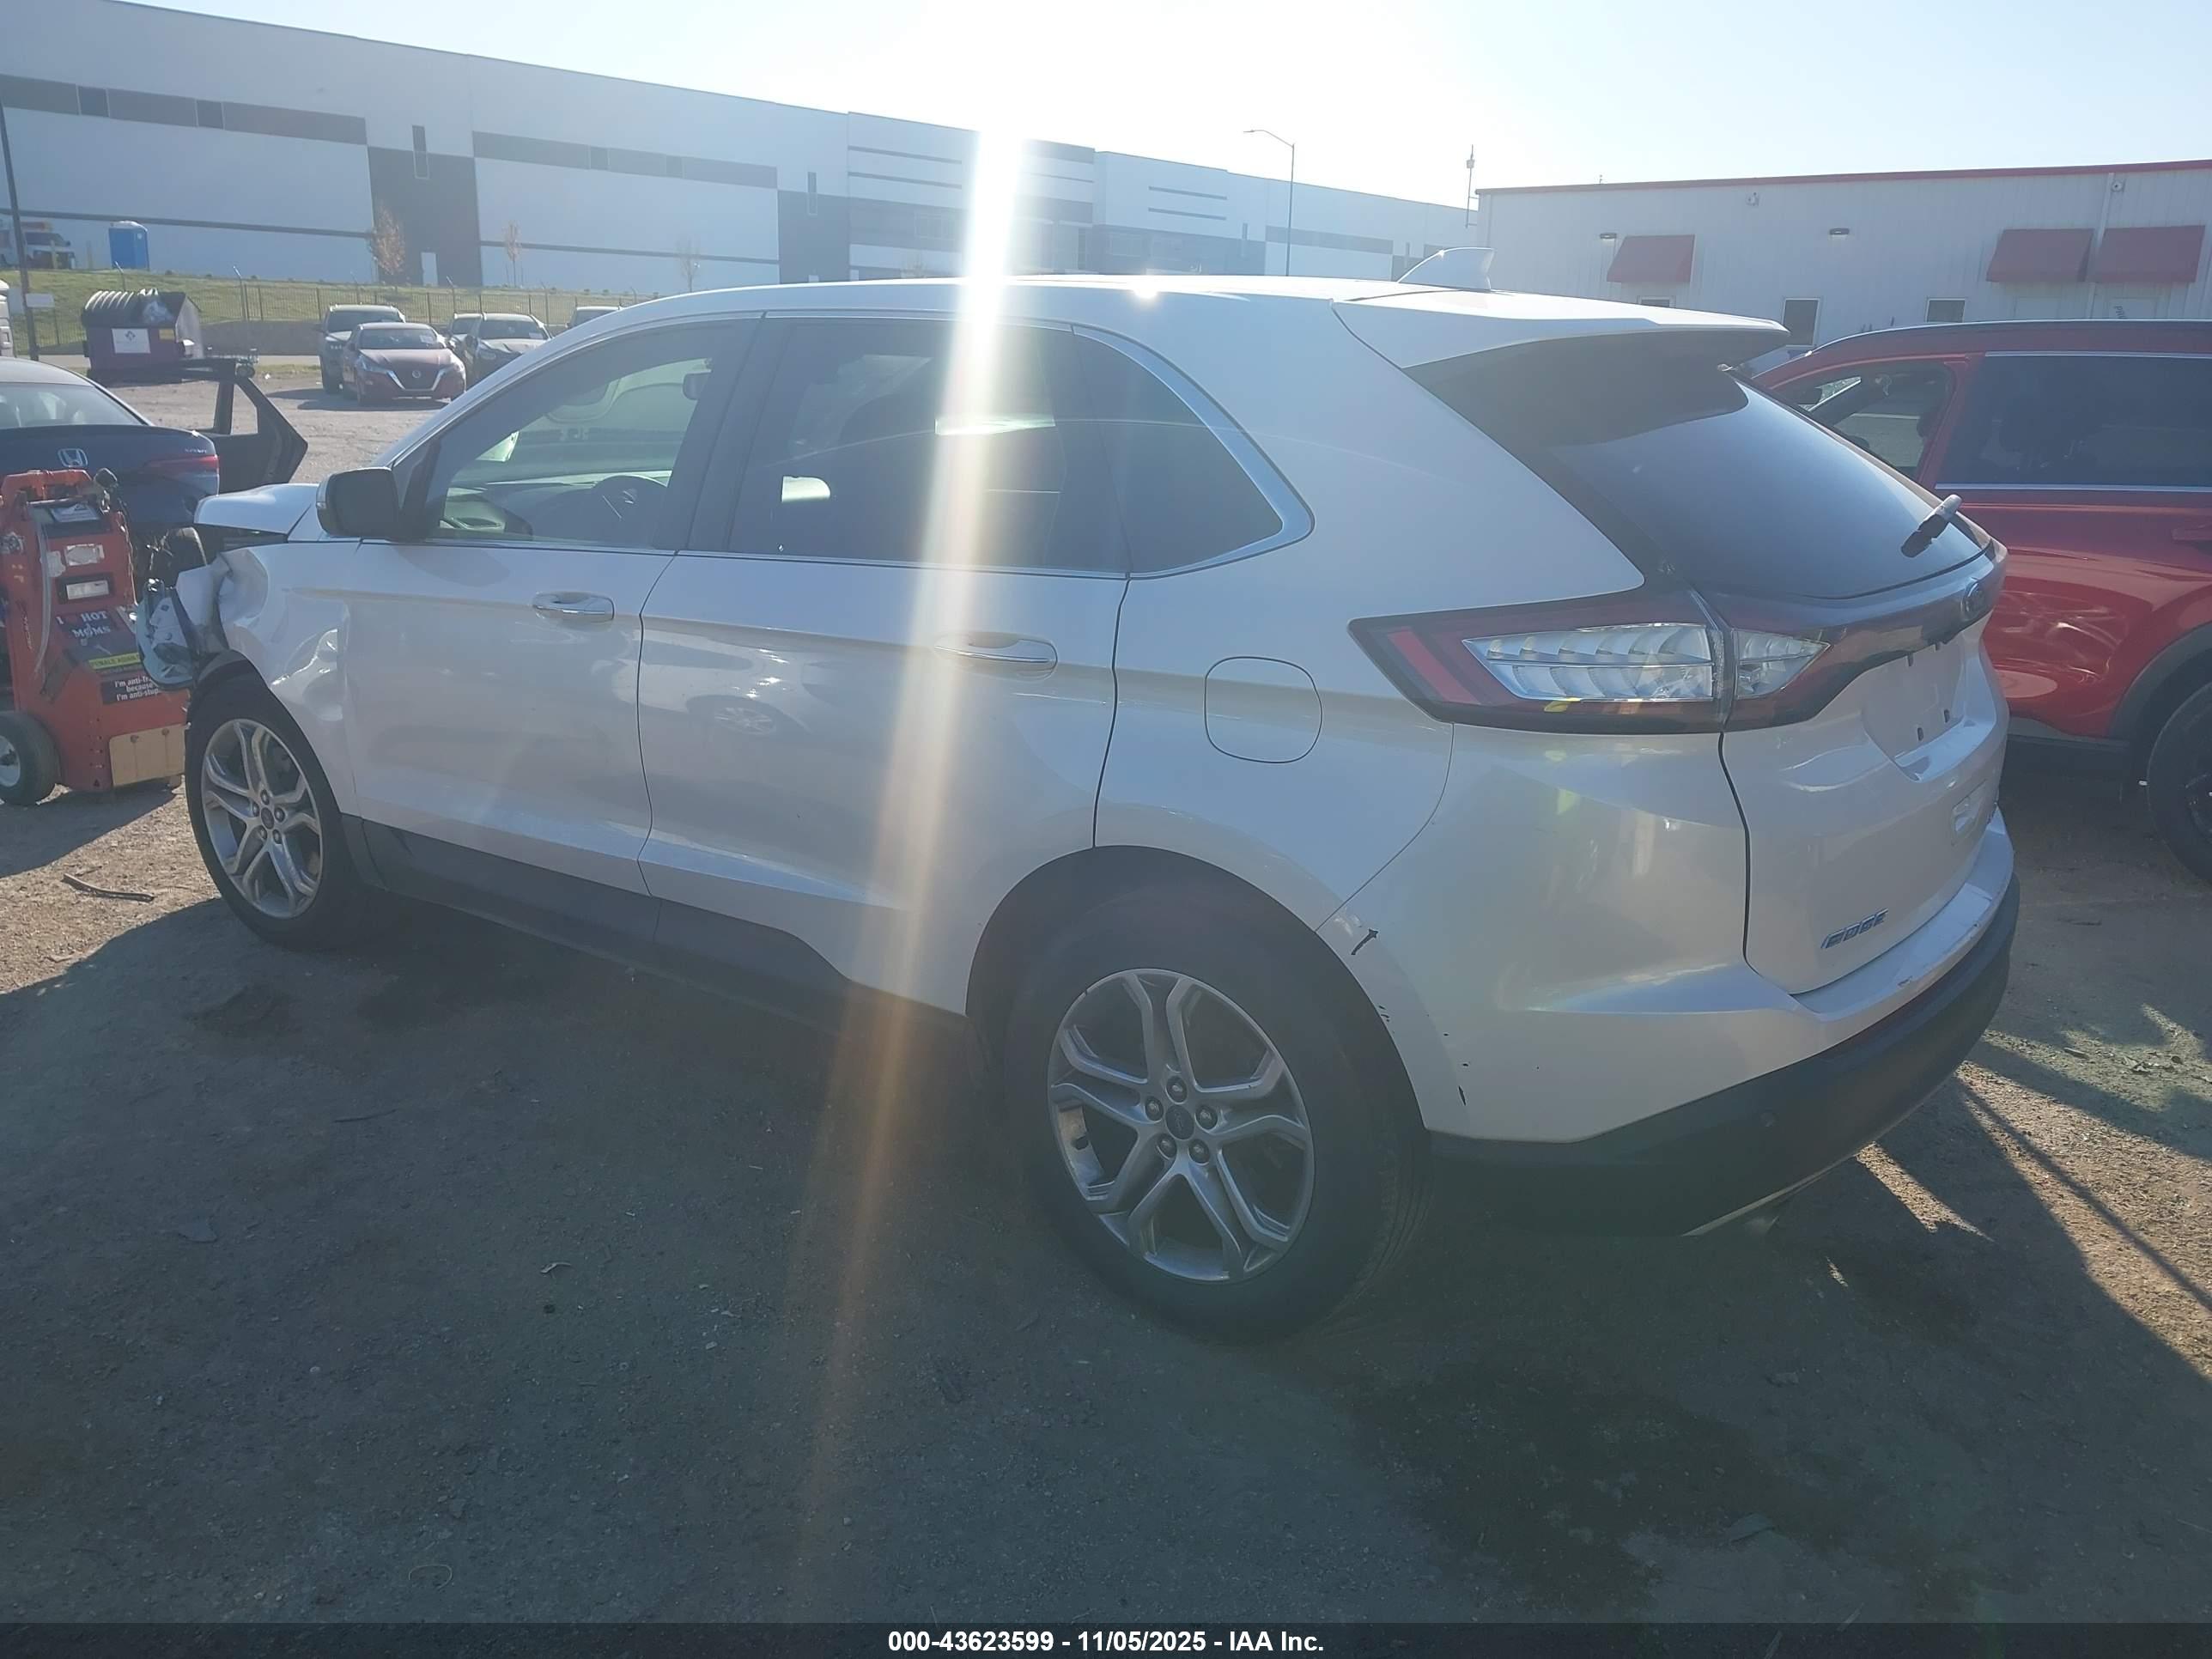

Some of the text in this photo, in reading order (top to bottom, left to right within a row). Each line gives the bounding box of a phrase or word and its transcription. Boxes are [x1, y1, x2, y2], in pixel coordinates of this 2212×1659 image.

[81, 611, 108, 623] HOT
[125, 683, 154, 693] because
[116, 688, 160, 702] I'm anti-stup
[1820, 908, 1888, 949] EDGE
